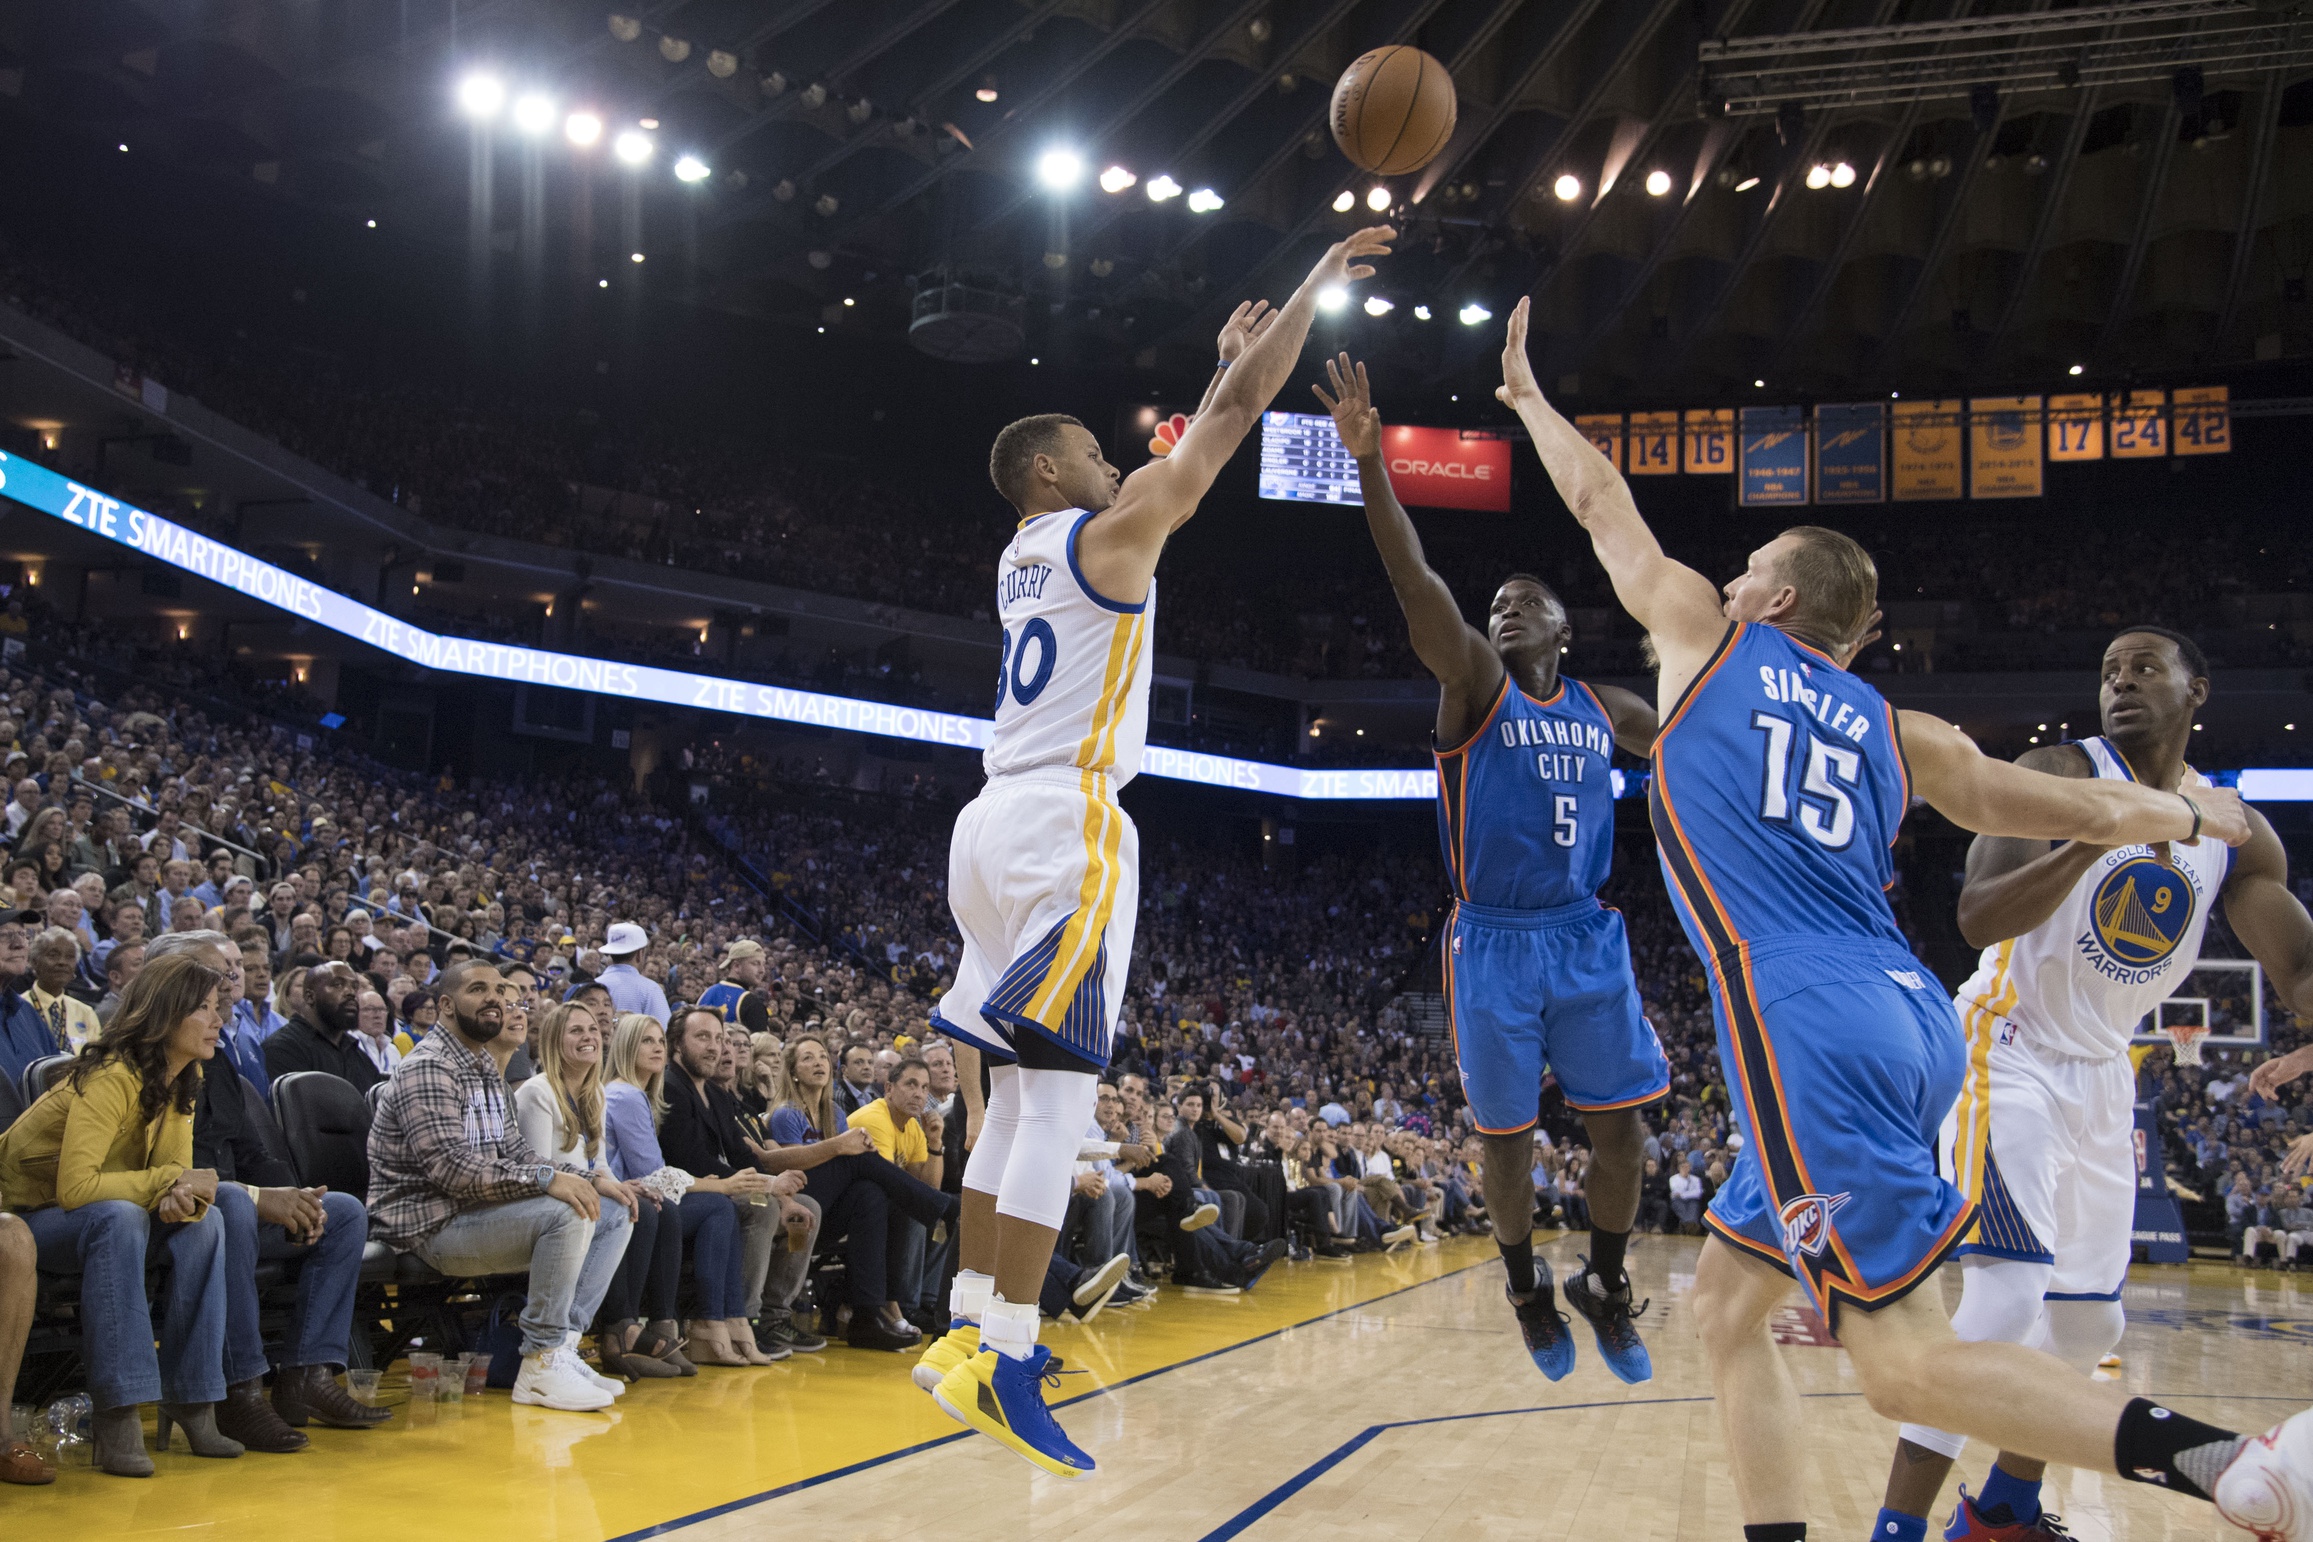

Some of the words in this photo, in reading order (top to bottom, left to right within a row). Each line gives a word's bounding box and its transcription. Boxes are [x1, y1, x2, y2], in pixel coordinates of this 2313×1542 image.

[1693, 432, 1725, 465] 16
[2059, 418, 2091, 451] 17
[2117, 415, 2160, 448] 24
[2181, 412, 2225, 445] 42
[1390, 458, 1490, 480] ORACLE
[1638, 433, 1668, 466] 14
[62, 482, 119, 537] ZTE
[126, 509, 323, 620] SMARTPHONES
[1000, 564, 1052, 612] CURRY
[361, 611, 400, 653] ZTE
[406, 627, 641, 696] SMARTPHONES
[692, 679, 747, 712] ZTE
[756, 688, 972, 745] SMARTPHONES
[1500, 718, 1611, 759] OKLAHOMA
[1140, 748, 1260, 789] TPHONES
[1302, 771, 1348, 798] ZTE
[1360, 771, 1438, 798] SMAR
[1537, 752, 1587, 784] CITY
[1750, 708, 1864, 853] 15
[1553, 793, 1579, 849] 5
[2105, 844, 2156, 867] GOLDE
[2172, 854, 2204, 898] STATE
[2150, 886, 2173, 914] 9
[2076, 930, 2173, 986] WARRIORS
[1788, 1203, 1818, 1252] OKC
